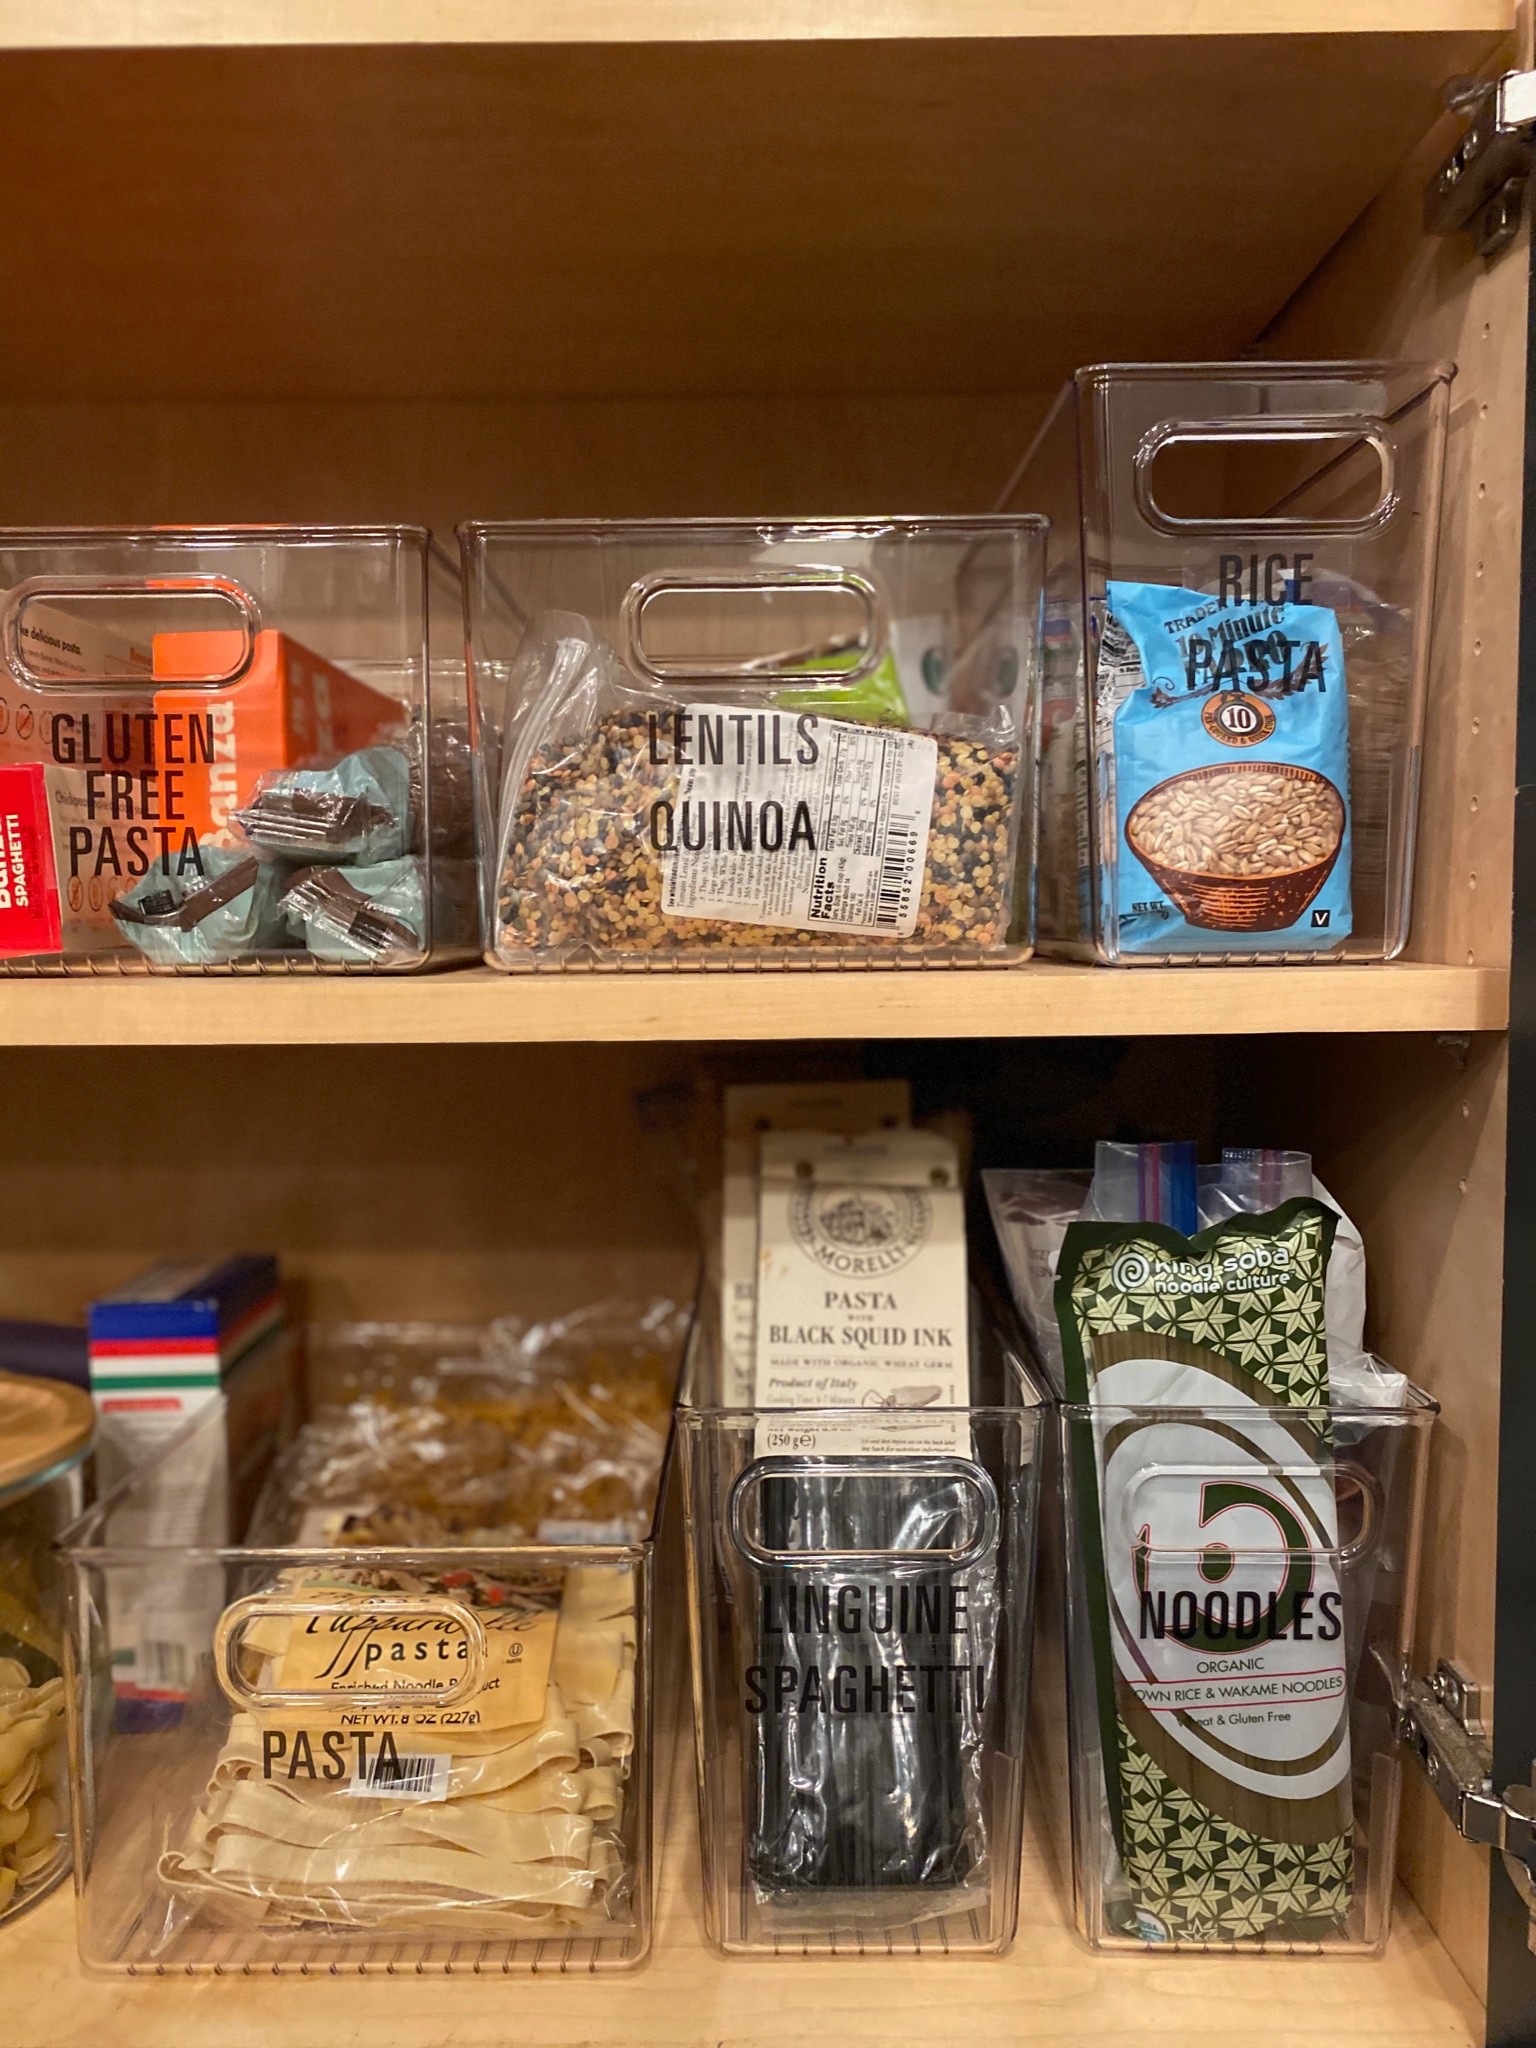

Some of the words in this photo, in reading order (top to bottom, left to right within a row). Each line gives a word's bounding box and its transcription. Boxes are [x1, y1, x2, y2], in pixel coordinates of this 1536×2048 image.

[1220, 553, 1313, 606] RICE
[1187, 638, 1326, 693] PASTA
[1227, 707, 1251, 729] 10
[51, 713, 214, 764] GLUTEN
[650, 713, 819, 766] LENTILS
[86, 770, 184, 820] FREE
[650, 800, 817, 852] QUINOA
[6, 814, 29, 907] SPAGHETTI
[69, 826, 205, 877] PASTA
[905, 830, 918, 871] 00669
[685, 868, 699, 908] Ingredients
[810, 856, 827, 918] Nutrition
[820, 880, 835, 919] Facts
[1314, 912, 1328, 926] V
[1223, 1244, 1290, 1273] soba
[825, 1291, 897, 1310] PASTA
[847, 1313, 874, 1323] WITH
[769, 1325, 835, 1345] BLACK
[841, 1326, 907, 1350] SQUID
[914, 1328, 953, 1348] INK
[771, 1358, 799, 1367] MADE
[804, 1358, 831, 1367] WITH
[834, 1358, 878, 1368] ORGANIC
[769, 1377, 813, 1389] Product
[815, 1377, 829, 1392] of
[830, 1377, 858, 1392] Italy
[763, 1584, 969, 1635] LINGUINE
[1140, 1590, 1342, 1641] NOODLES
[365, 1637, 468, 1670] pasta
[1196, 1657, 1265, 1674] ORGANIC
[744, 1664, 985, 1714] SPAGHETTI
[1134, 1689, 1171, 1703] OWN
[1174, 1688, 1202, 1702] RICE
[1205, 1687, 1216, 1699] &
[1218, 1683, 1278, 1699] WAKAME
[1282, 1675, 1343, 1695] NOODLES
[341, 1713, 372, 1726] NET
[401, 1714, 410, 1725] 8
[440, 1710, 482, 1727] (227g)
[1216, 1714, 1226, 1726] &
[1228, 1711, 1264, 1726] Gluten
[1267, 1711, 1292, 1723] Free
[262, 1730, 402, 1781] PASTA
